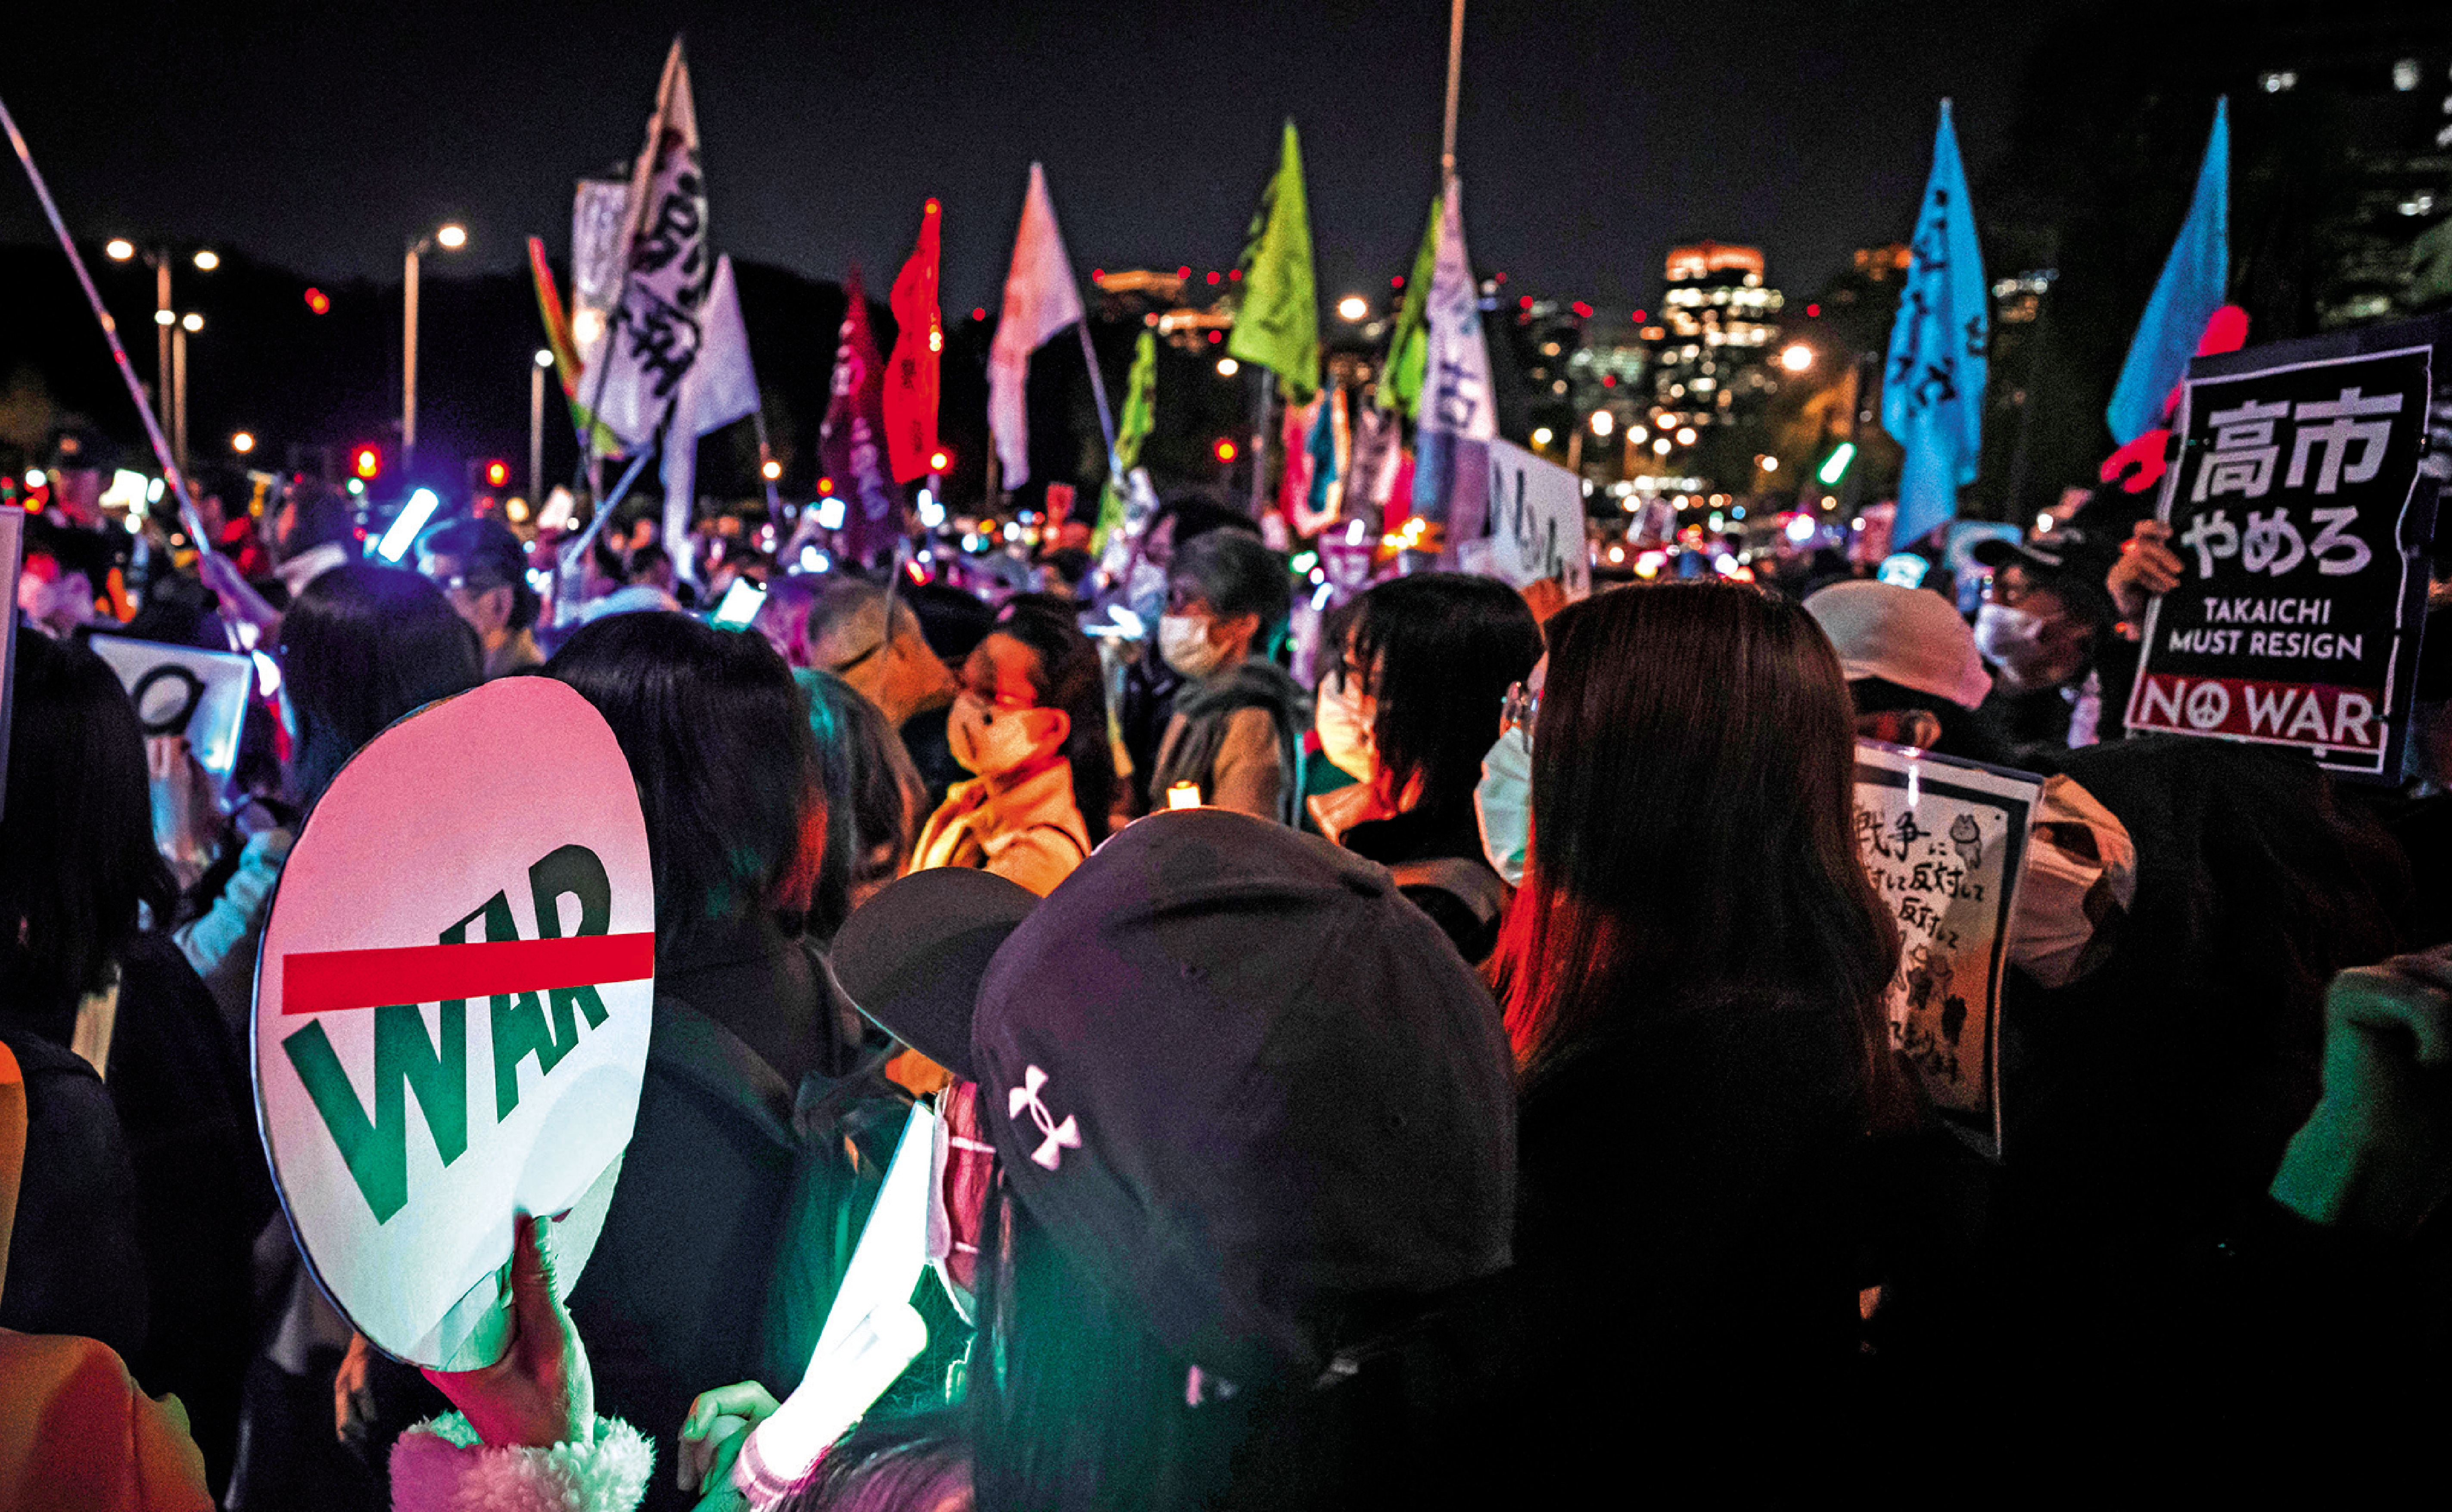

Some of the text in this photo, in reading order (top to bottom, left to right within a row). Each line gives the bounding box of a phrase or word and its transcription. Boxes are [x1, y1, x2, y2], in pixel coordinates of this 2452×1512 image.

[2191, 387, 2403, 502] 高市
[2181, 507, 2371, 579] やめろ
[2169, 628, 2362, 660] MUST RESIGN
[2204, 597, 2332, 625] TAKAICHI
[2140, 676, 2374, 745] NO WAR
[282, 844, 612, 1226] WAR
